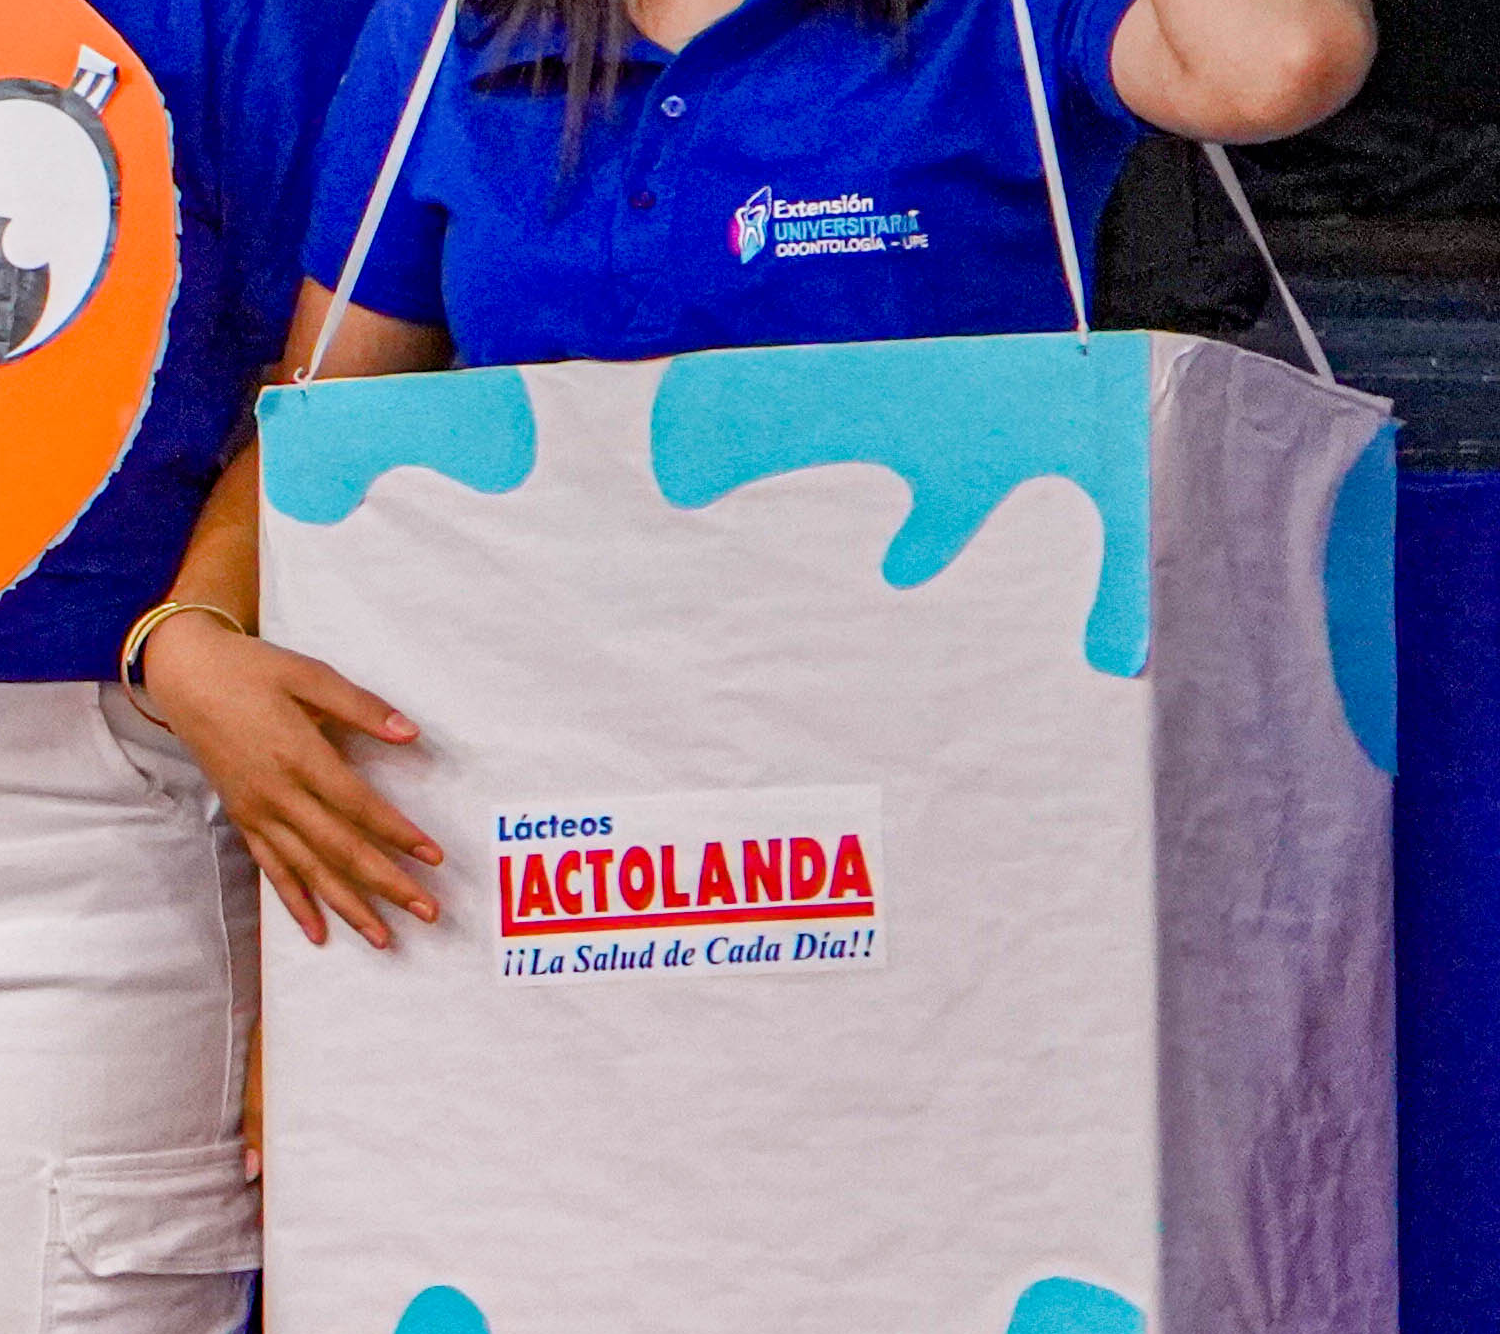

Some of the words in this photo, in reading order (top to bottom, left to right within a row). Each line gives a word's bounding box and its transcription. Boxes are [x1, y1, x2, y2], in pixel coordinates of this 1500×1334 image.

[773, 193, 874, 219] Extensión
[774, 212, 920, 242] UNIVERSITARIA
[775, 234, 887, 257] ODONTOLOGÍA
[902, 233, 930, 250] UPE
[499, 814, 613, 842] Lácteos
[499, 834, 875, 937] LACTOLANDA
[504, 946, 565, 977] ¡¡La
[573, 941, 655, 973] Salud
[663, 938, 696, 967] de
[706, 934, 782, 965] Cada
[792, 928, 876, 961] Día!!
